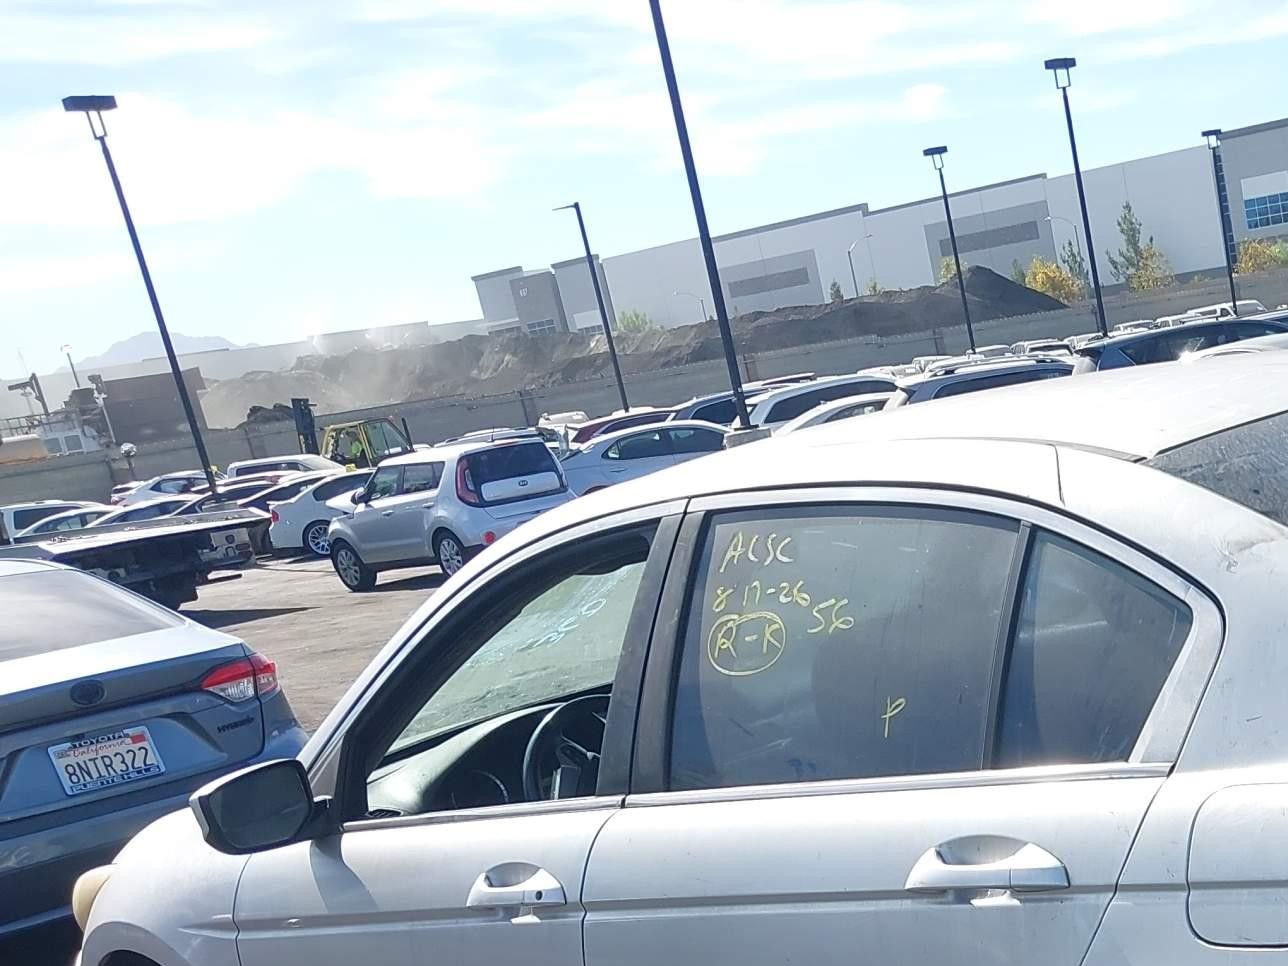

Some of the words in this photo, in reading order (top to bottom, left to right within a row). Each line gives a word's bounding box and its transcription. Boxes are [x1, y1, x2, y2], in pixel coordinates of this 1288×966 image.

[719, 531, 794, 573] ACSC
[807, 598, 855, 635] 56
[73, 730, 125, 748] TOYOTA
